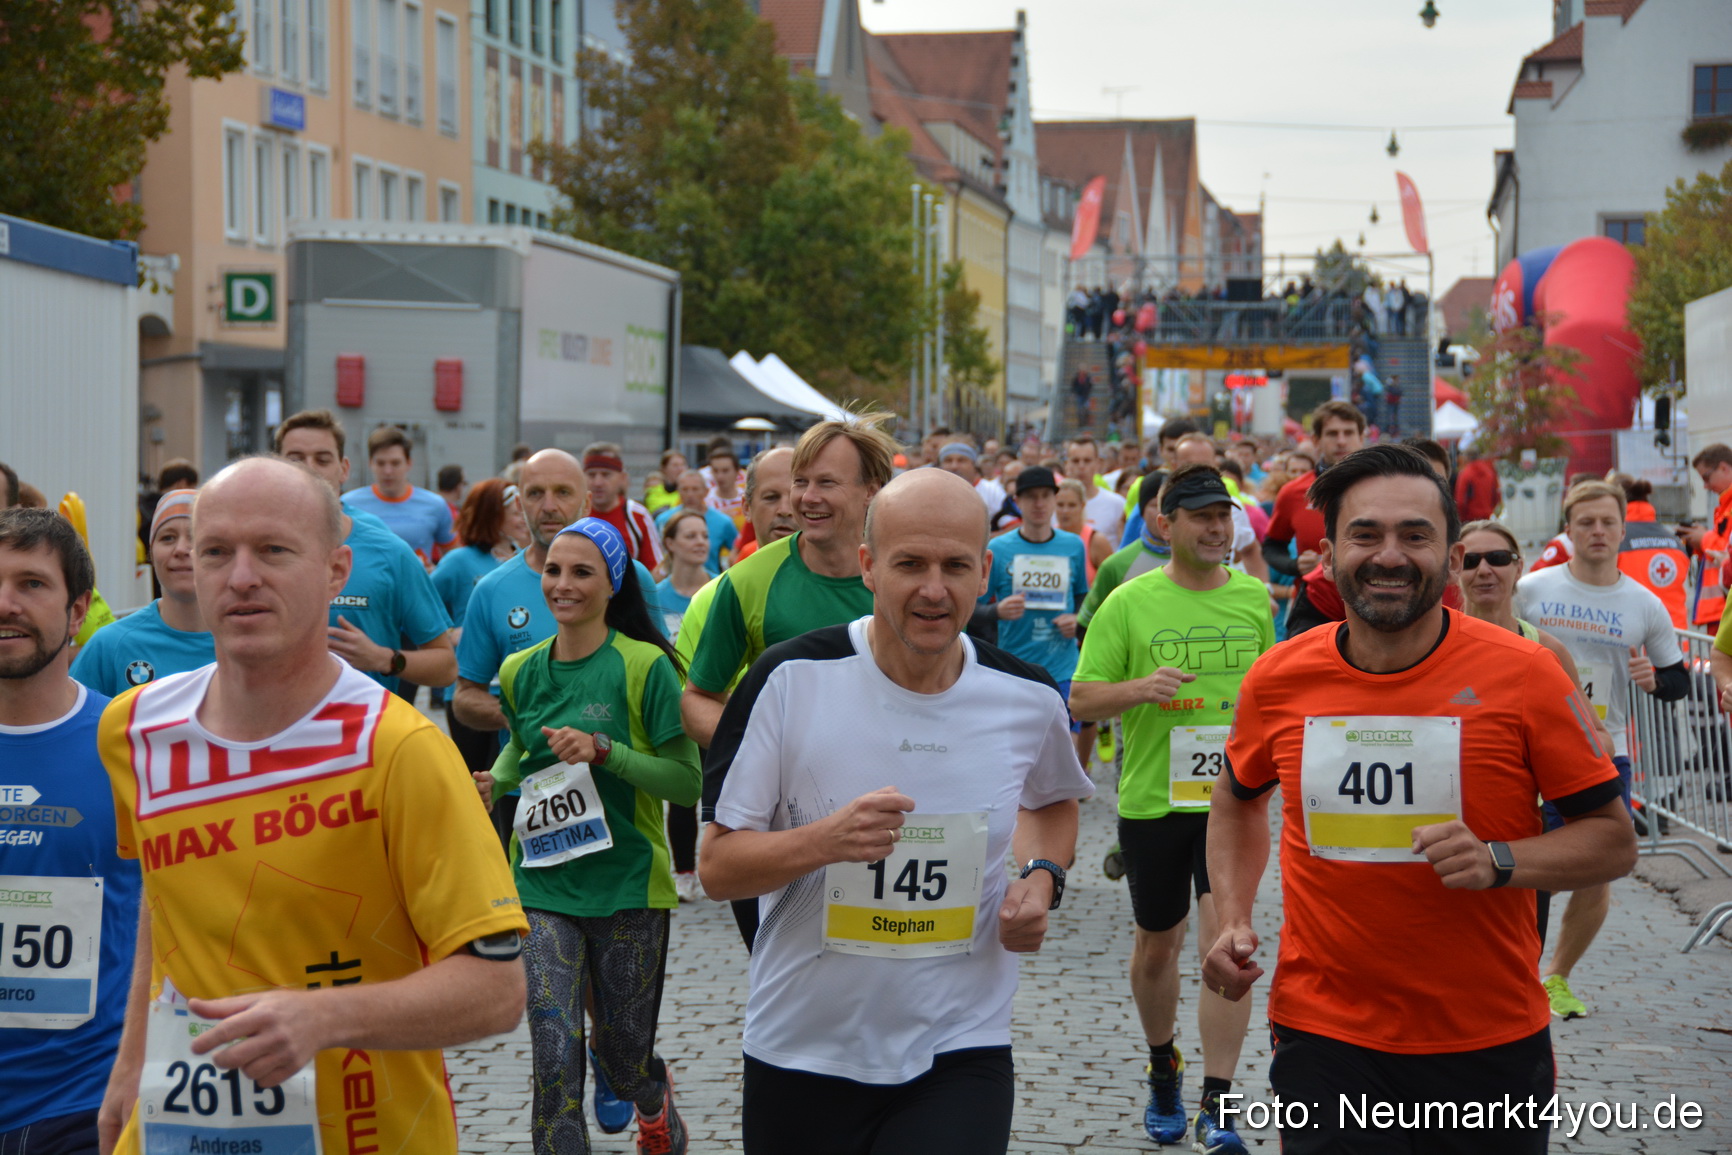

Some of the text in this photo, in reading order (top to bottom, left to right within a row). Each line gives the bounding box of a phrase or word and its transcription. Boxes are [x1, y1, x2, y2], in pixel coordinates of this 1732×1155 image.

[232, 278, 269, 317] D
[1022, 572, 1061, 588] 2320
[329, 595, 369, 606] OCK
[1539, 617, 1607, 635] NÜRNBERG
[1540, 602, 1624, 627] VR BANK
[1360, 730, 1413, 742] BOCK
[1338, 761, 1414, 805] 401
[0, 807, 67, 824] ORGEN
[526, 789, 587, 832] 2760
[142, 789, 379, 873] MAX BÖGL
[530, 824, 598, 855] BETTINA
[867, 859, 948, 901] 145
[872, 916, 935, 936] Stephan
[163, 1061, 286, 1116] 2615
[189, 1135, 263, 1154] Andreas
